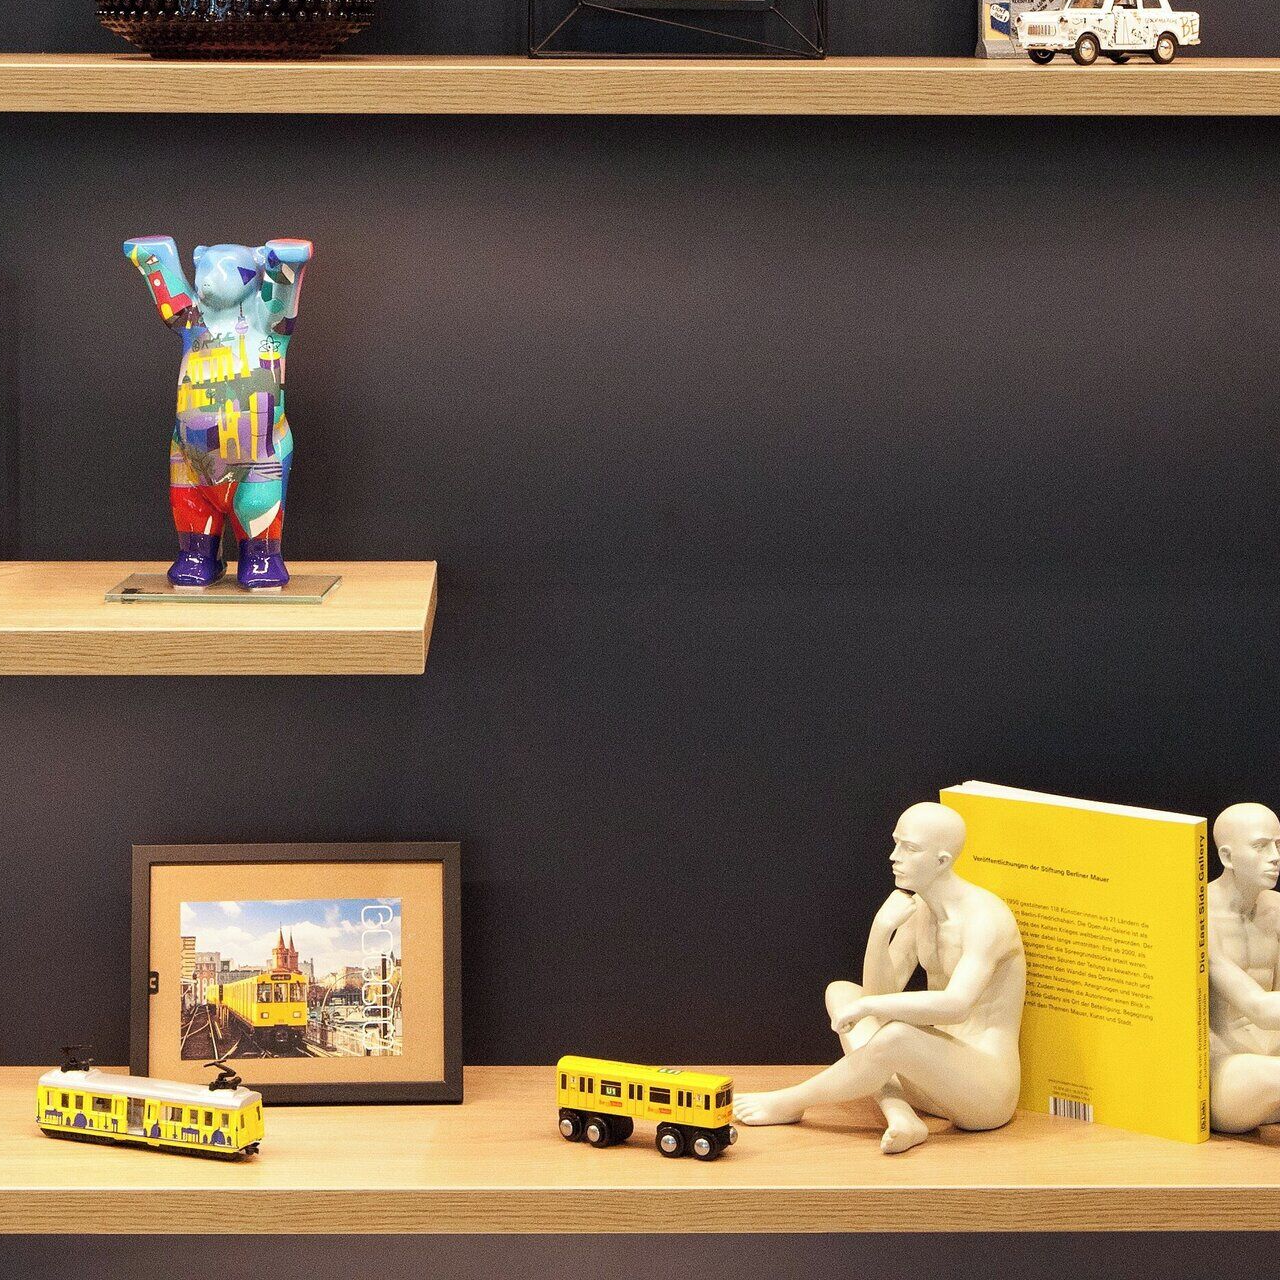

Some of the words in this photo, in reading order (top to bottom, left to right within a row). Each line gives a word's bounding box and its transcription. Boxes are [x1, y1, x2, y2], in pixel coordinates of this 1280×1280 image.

[973, 855, 1028, 870] Veröffentlichungen
[1041, 865, 1065, 876] Stiftung
[1066, 869, 1089, 879] Berliner
[1090, 873, 1109, 883] Mauer
[606, 1087, 616, 1095] U1
